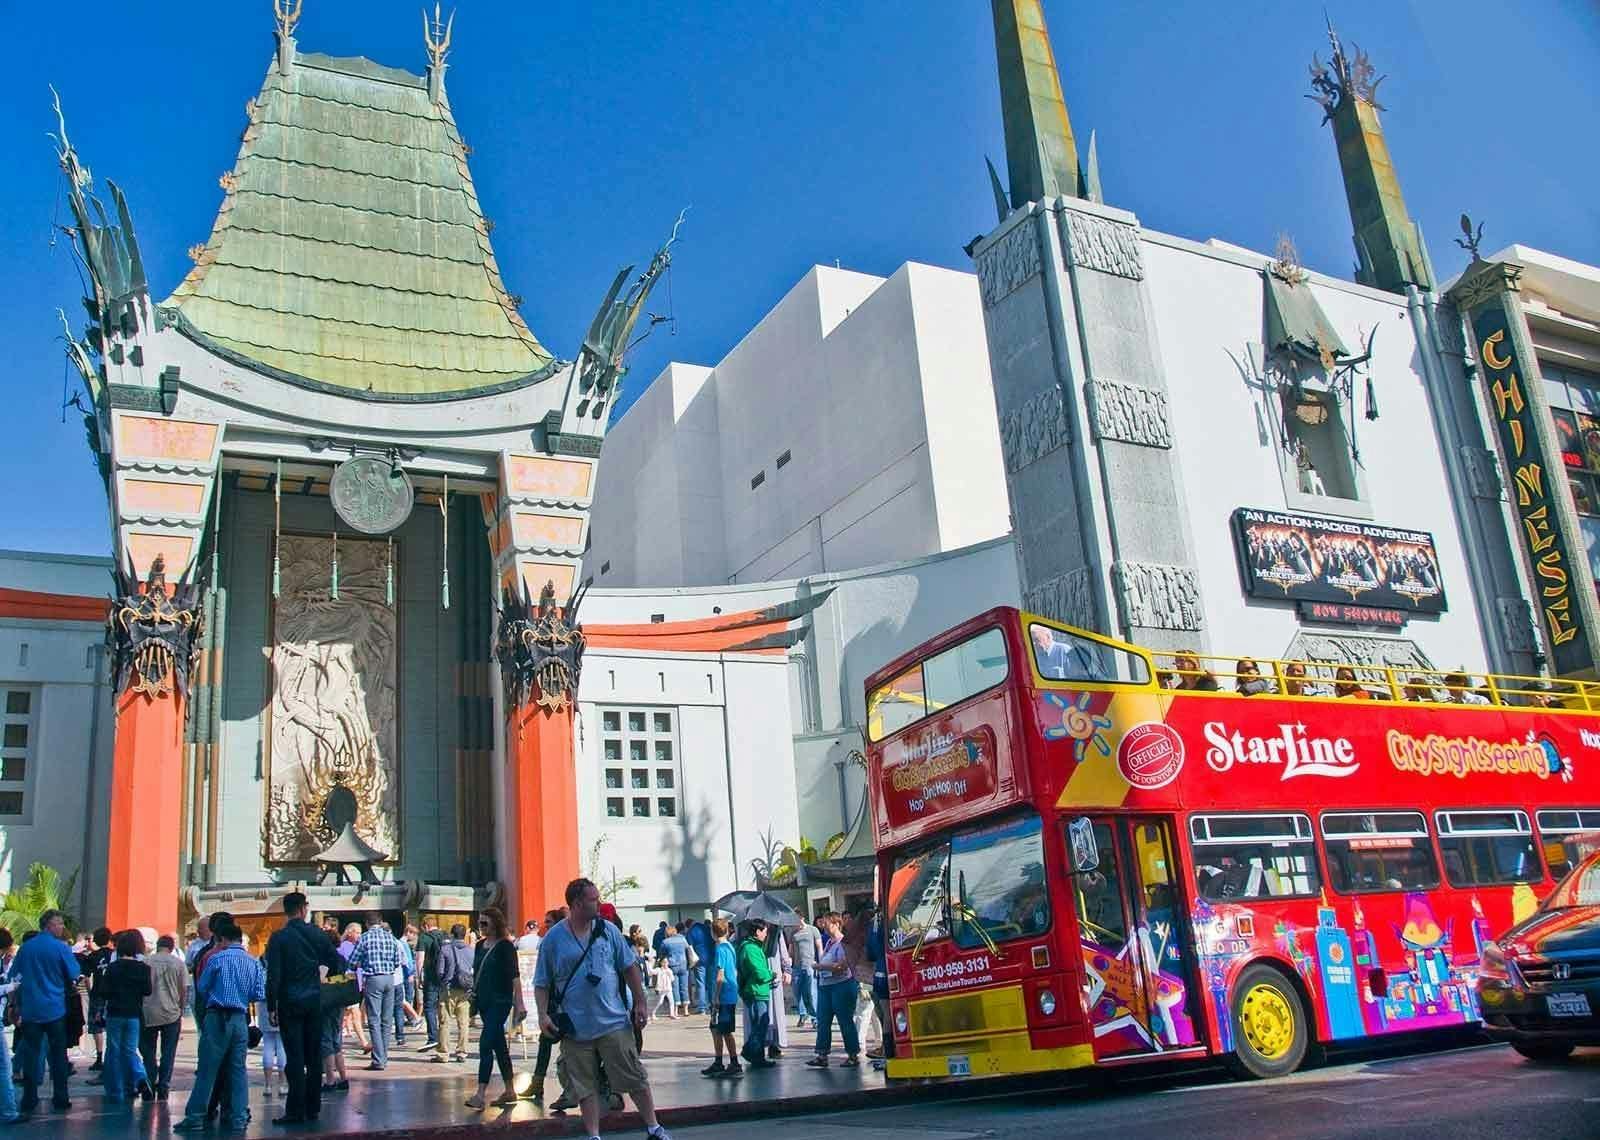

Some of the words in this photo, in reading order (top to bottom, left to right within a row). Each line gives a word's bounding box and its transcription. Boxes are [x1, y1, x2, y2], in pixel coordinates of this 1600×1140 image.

[1482, 329, 1577, 646] CHINESE
[1267, 515, 1361, 535] ACTION-PACKED
[1312, 604, 1338, 617] NOW
[1344, 607, 1402, 624] SHOWING
[1130, 741, 1170, 768] OFFICIAL
[1203, 720, 1360, 781] StarLine
[909, 799, 925, 812] Hop
[921, 956, 991, 981] 1-800-959-3131
[922, 975, 993, 993] www.StarLineTours.com
